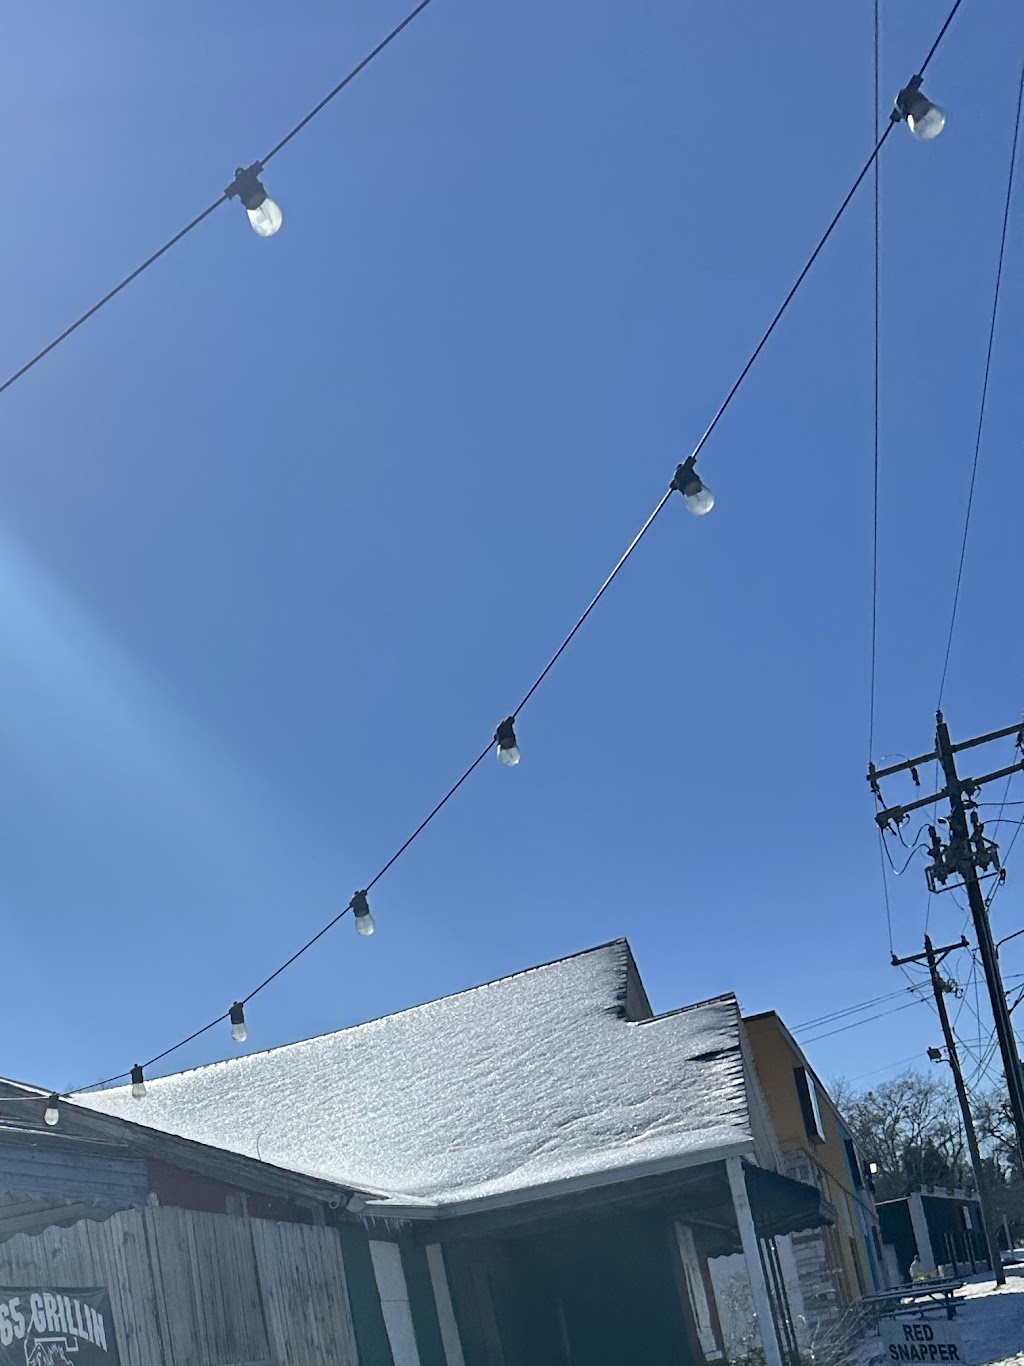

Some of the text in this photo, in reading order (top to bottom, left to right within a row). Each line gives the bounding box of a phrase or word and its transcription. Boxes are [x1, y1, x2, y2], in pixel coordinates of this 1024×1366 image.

[30, 1292, 108, 1352] GRILLIN
[888, 1323, 961, 1361] RED SNAPPER
